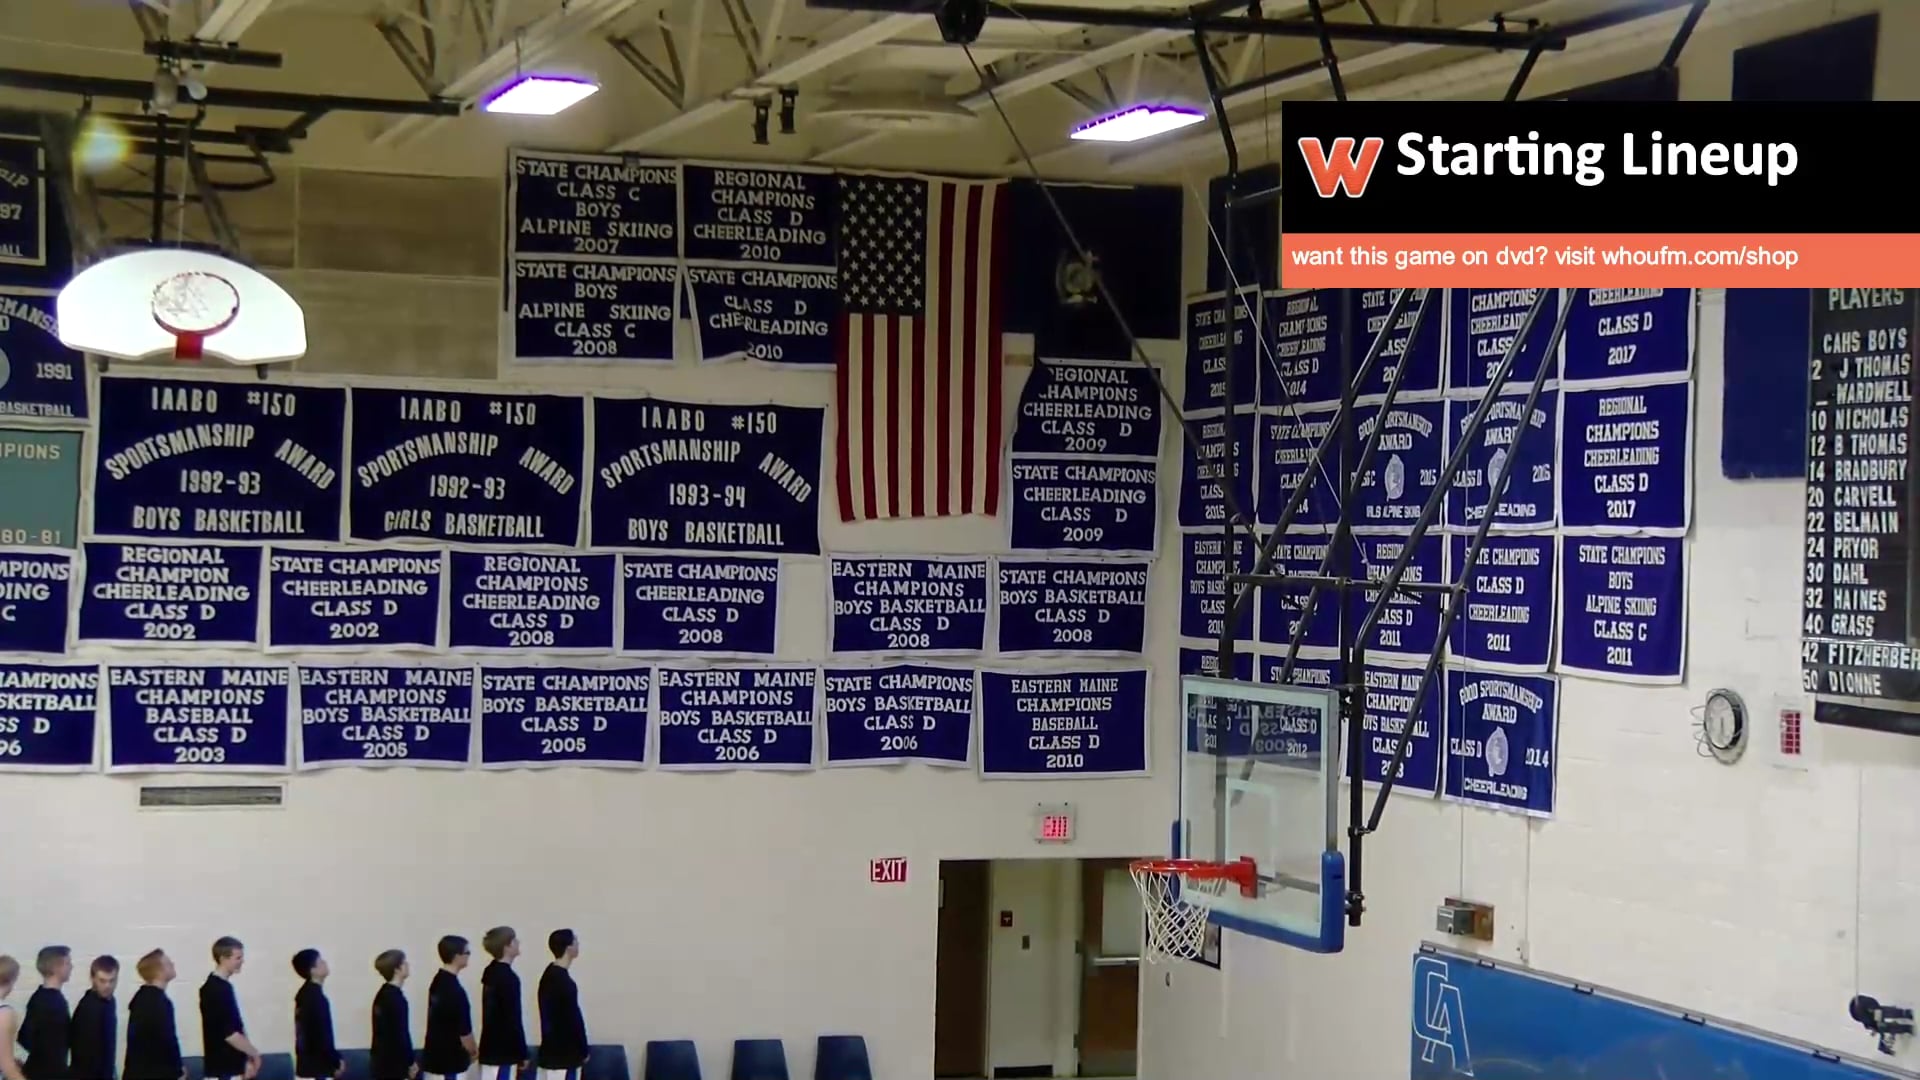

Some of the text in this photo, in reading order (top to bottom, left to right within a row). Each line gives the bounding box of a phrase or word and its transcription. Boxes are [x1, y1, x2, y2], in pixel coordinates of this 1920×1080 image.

[516, 160, 678, 184] STATE CHAMPIONS
[714, 170, 805, 191] REGIONAL
[557, 182, 640, 201] CLASS C
[711, 189, 815, 210] CHAMPIONS
[576, 201, 621, 219] BOYS
[718, 208, 803, 226] CLASS D
[521, 219, 673, 238] ALPINE SKIING
[693, 224, 826, 244] CHEERLEADING
[574, 237, 619, 253] 2007
[740, 243, 781, 261] 2010
[517, 263, 677, 282] STATE CHAMPIONS
[691, 268, 838, 290] STATE CHAMPIONS
[575, 283, 617, 299] BOYS
[1829, 288, 1904, 311] PLAYERS
[519, 303, 672, 321] ALPINE SKIING
[724, 296, 807, 315] CLASS D
[554, 322, 636, 338] CLASS C
[1598, 312, 1652, 336] CLASS D
[573, 340, 617, 355] 2008
[1823, 327, 1907, 354] CAHS BOYS
[1608, 344, 1636, 365] 2017
[36, 363, 73, 380] 1991
[1812, 353, 1910, 380] 2 J THOMAS
[152, 387, 296, 417] IAABO #150
[1837, 381, 1912, 405] WARDWELL
[401, 396, 536, 425] IAABO #150
[1599, 396, 1647, 417] REGIONAL
[642, 406, 777, 434] IAABO #150
[1811, 407, 1909, 431] 10 NICHOLAS
[1586, 420, 1659, 442] CHAMPIONS
[1811, 433, 1908, 456] 12 B THOMAS
[105, 423, 336, 490] SPORTSMANSHIP AWARD
[357, 431, 575, 495] SPORTSMANSHIP AWARD
[1584, 447, 1659, 467] CHEERLEADING
[600, 439, 812, 503] SPORTSMANSHIP AWARD
[1013, 465, 1156, 484] STATE CHAMPIONS
[1810, 459, 1908, 481] 14 BRADBURY
[180, 469, 261, 495] 1992-93
[430, 475, 505, 500] 1992-93
[1595, 473, 1648, 493] CLASS D
[669, 483, 746, 508] 1993-94
[1024, 488, 1146, 503] CHEERLEADING
[1808, 485, 1896, 507] 20 CARVELL
[1041, 507, 1127, 522] CLASS D
[1607, 500, 1636, 518] 2017
[133, 506, 304, 533] BOYS BASKETBALL
[384, 509, 544, 538] GIRLS BASKETBALL
[1807, 512, 1898, 533] 22 BELMAIN
[628, 518, 784, 545] BOYS BASKETBALL
[1063, 527, 1103, 541] 2009
[121, 546, 224, 564] REGIONAL
[1493, 548, 1539, 565] CHAMPIONS
[1579, 545, 1665, 565] STATE CHAMPIONS
[1807, 537, 1879, 559] 24 PRYOR
[116, 567, 229, 583] CHAMPION
[1609, 572, 1633, 590] BOYS
[1807, 563, 1869, 584] 30 DAHL
[93, 583, 250, 601] CHEERLEADING
[1477, 576, 1524, 593] CLASS D
[1586, 595, 1656, 616] ALPINE SKIING
[1806, 588, 1887, 611] 32 HAINES
[124, 604, 216, 620] CLASS D
[1469, 604, 1530, 623] CHEERLEADING
[143, 624, 196, 640] 2002
[1594, 620, 1647, 641] CLASS C
[1805, 614, 1874, 636] 40 GRASS
[1487, 634, 1511, 651] 2011
[1607, 647, 1633, 666] 2011
[1802, 643, 1818, 663] 42
[111, 669, 289, 686] EASTERN MAINE
[1011, 678, 1119, 694] EASTERN MAINE
[1804, 670, 1881, 695] 50 DIONNE
[136, 689, 265, 705] CHAMPIONS
[1017, 697, 1112, 711] CHAMPIONS
[1480, 680, 1543, 713] SPORTSMANSHIP
[146, 708, 253, 724] BASEBALL
[1482, 703, 1517, 724] AWARD
[1032, 717, 1098, 731] BASEBALL
[154, 727, 247, 743] CLASS D
[1029, 735, 1100, 750] CLASS D
[174, 747, 225, 763] 2003
[1450, 738, 1482, 758] CLASS D
[1046, 754, 1083, 768] 2010
[1464, 778, 1528, 800] CHEERLEADING
[873, 860, 904, 880] EXIT
